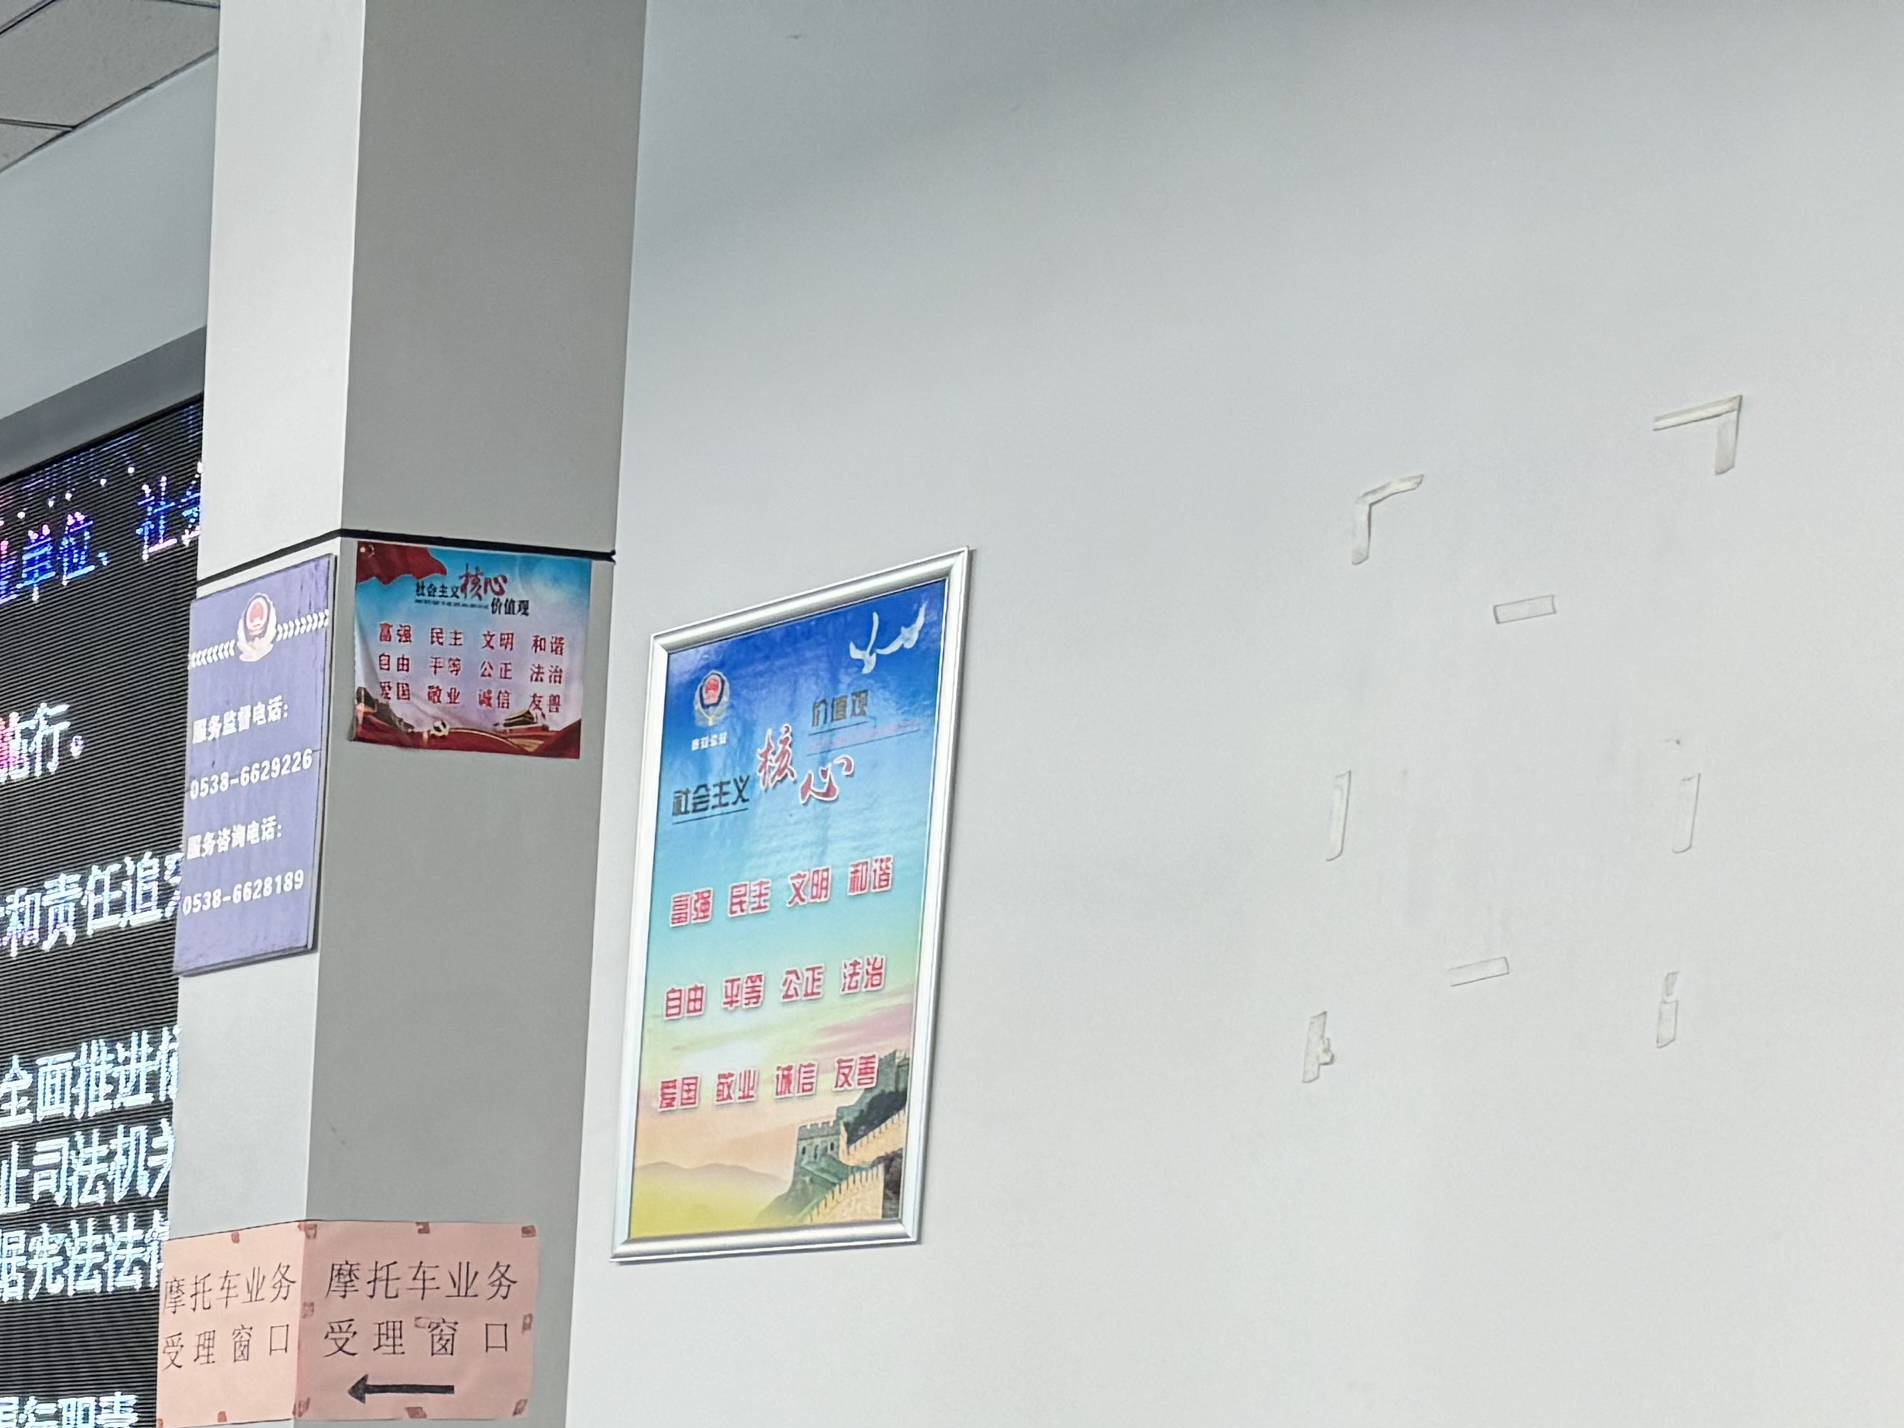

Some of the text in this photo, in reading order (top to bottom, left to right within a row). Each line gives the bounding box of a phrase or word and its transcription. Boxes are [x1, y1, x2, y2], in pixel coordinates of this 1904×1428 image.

[458, 563, 509, 599] 核心
[379, 623, 565, 657] 富强 民主 文明 和谐
[379, 653, 564, 685] 自由 平等 公正 法治
[379, 681, 561, 714] 爱国 敬业 诚信 友善
[189, 748, 313, 801] 0538-6629226
[672, 774, 751, 818] 社会主义
[182, 868, 305, 916] 0538-6628189
[669, 855, 894, 929] 富强 民主 文明 和谐
[663, 955, 887, 1021] 自由 平等 公正 法治
[656, 1052, 878, 1113] 爱国 敬业 诚信 友善
[163, 1261, 297, 1314] 摩托车业务
[324, 1259, 518, 1301] 摩托车业务
[162, 1323, 290, 1371] 受理窗口
[323, 1317, 510, 1358] 受理窗口
